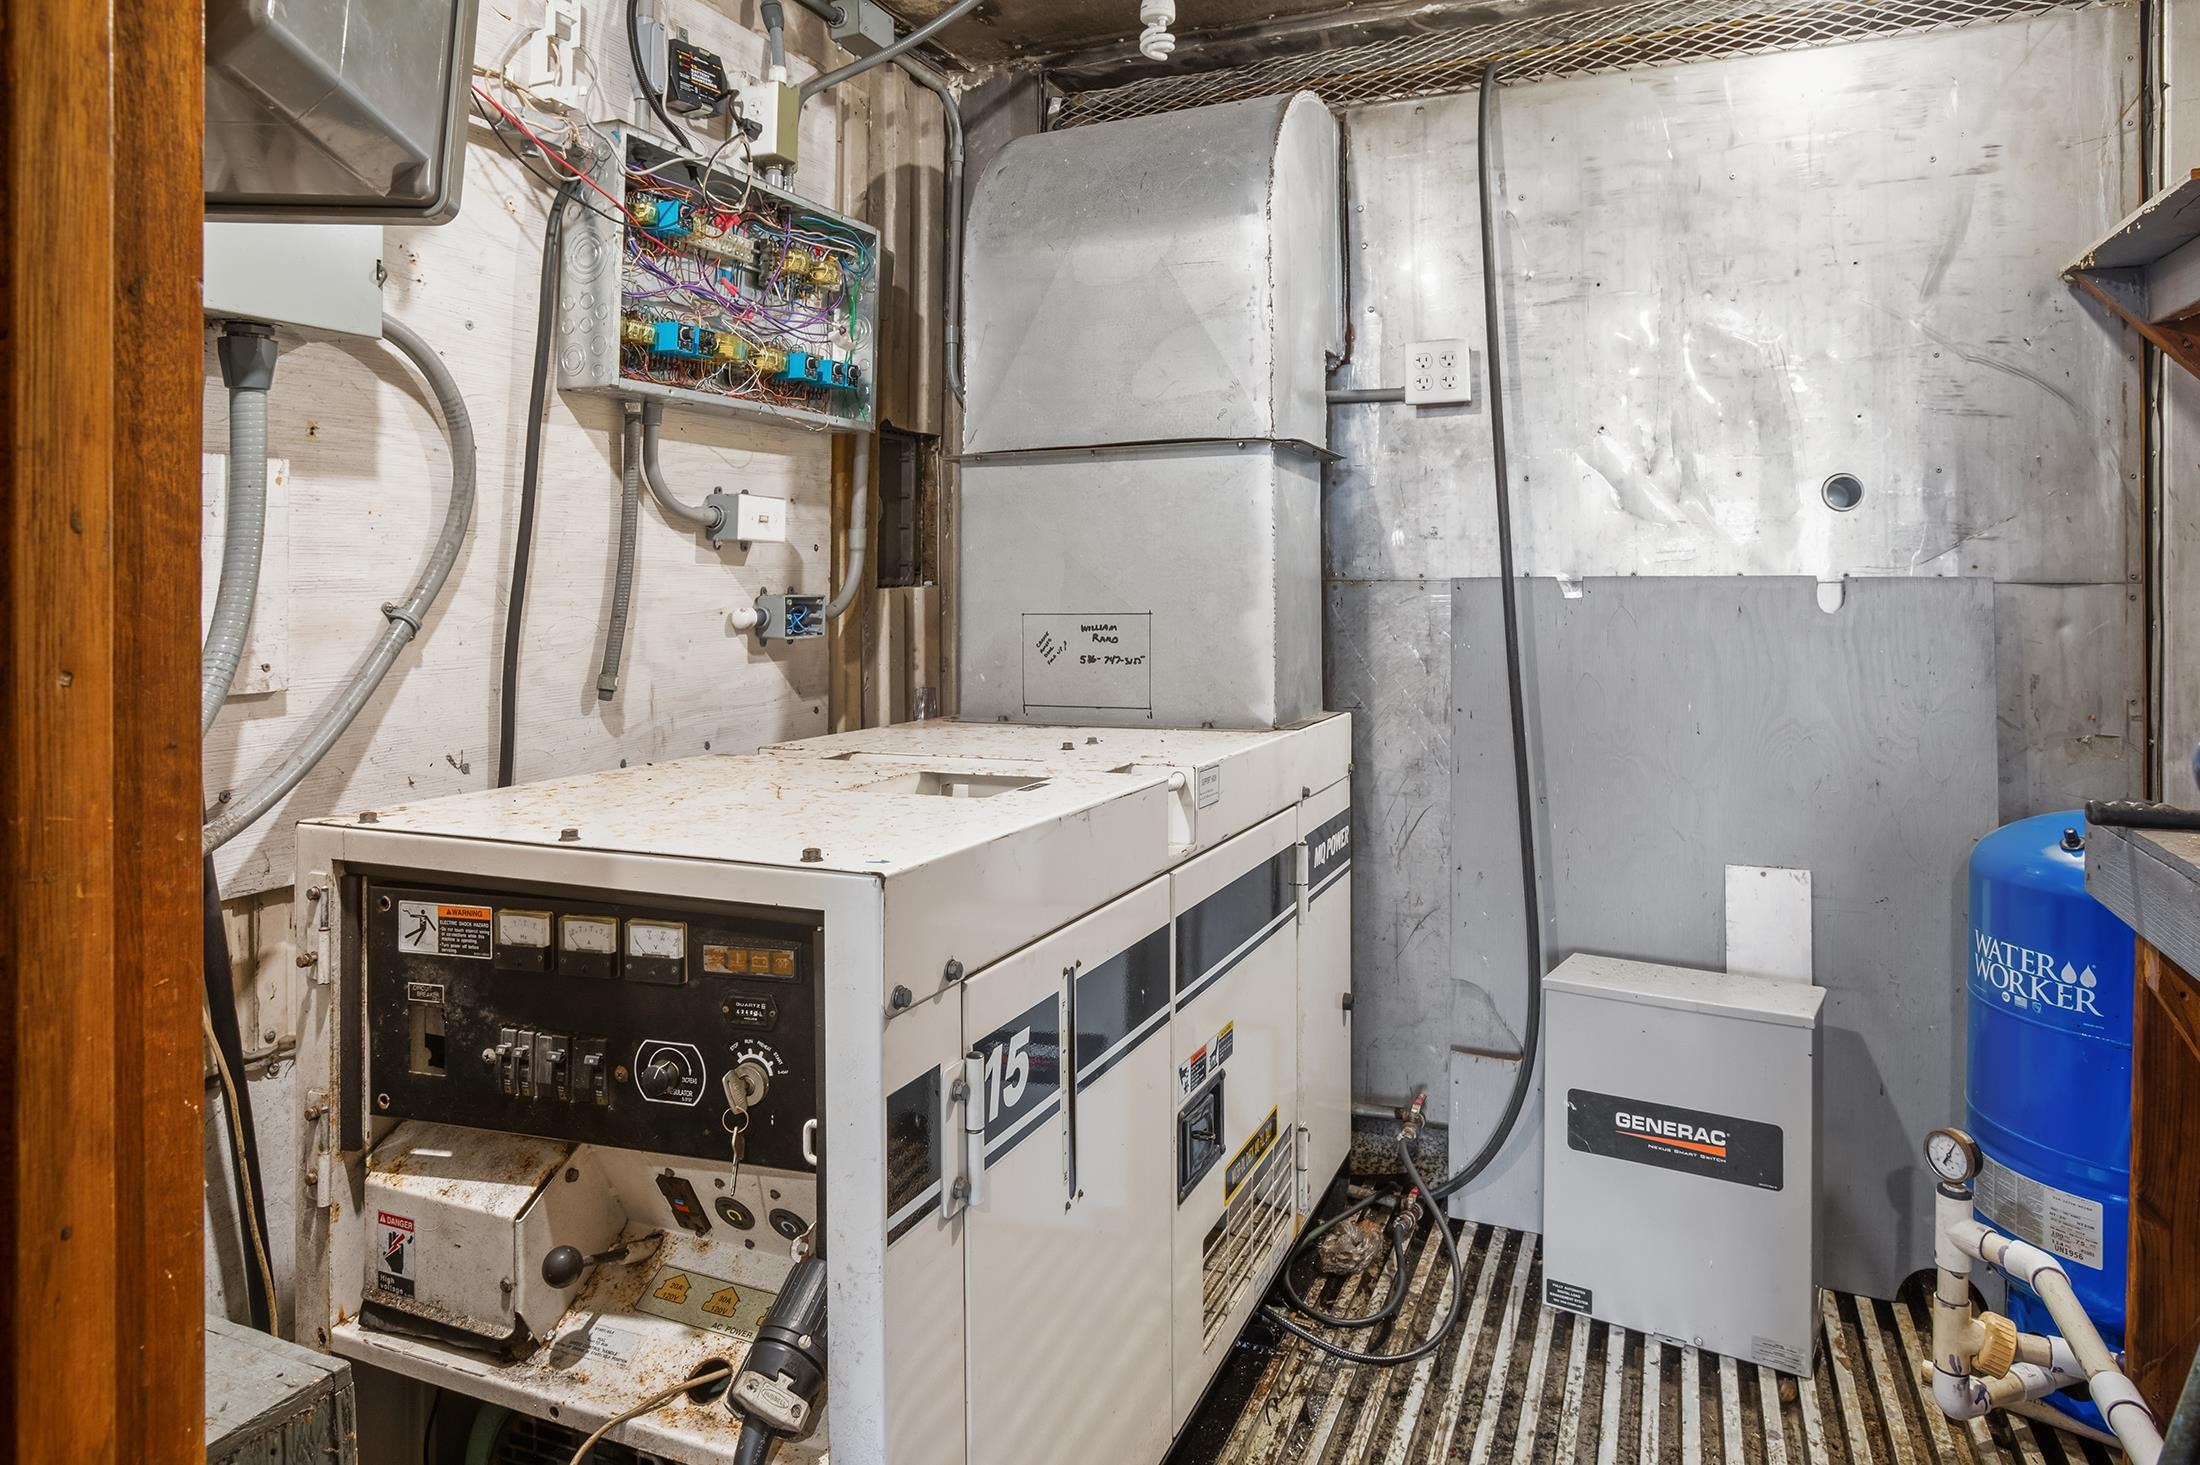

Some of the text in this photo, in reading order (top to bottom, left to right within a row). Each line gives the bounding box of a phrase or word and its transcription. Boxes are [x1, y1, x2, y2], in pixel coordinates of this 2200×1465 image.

[1313, 825, 1349, 868] MQ POWER
[453, 909, 483, 918] WARNING
[1975, 929, 2062, 982] WATER
[1975, 952, 2104, 1017] WORKER
[736, 1001, 760, 1009] QUARTZ
[730, 1041, 738, 1051] STOP
[773, 1051, 783, 1065] START
[984, 1026, 1031, 1124] 15
[1615, 1112, 1727, 1146] GENERAC
[1674, 1149, 1697, 1157] SMART
[1700, 1154, 1726, 1163] SWITCH
[386, 1216, 413, 1230] DANGER
[2054, 1245, 2084, 1260] UN1956
[380, 1273, 395, 1284] High
[662, 1292, 678, 1301] 120V
[711, 1322, 753, 1339] AC POWER
